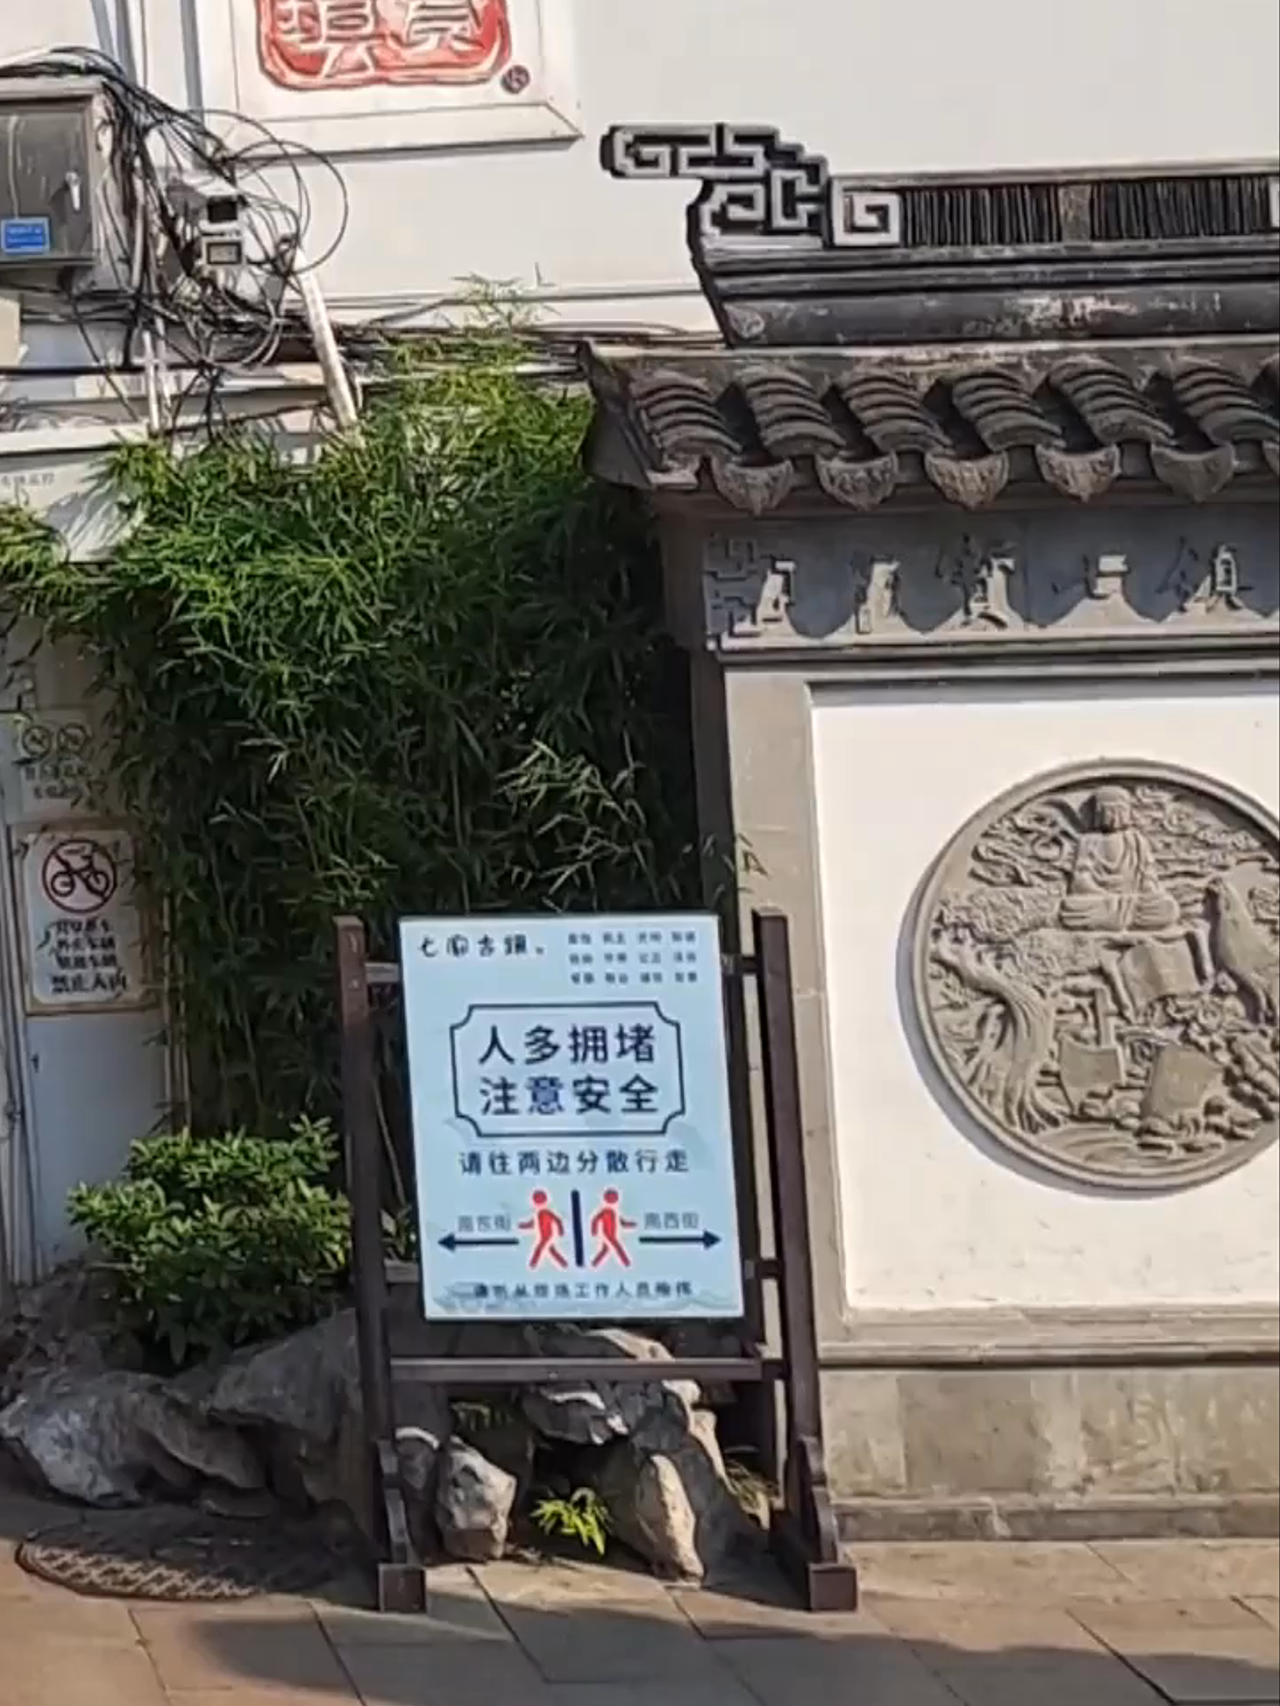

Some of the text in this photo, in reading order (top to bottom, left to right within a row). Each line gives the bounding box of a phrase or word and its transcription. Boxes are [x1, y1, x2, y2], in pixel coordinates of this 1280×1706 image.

[477, 1023, 656, 1064] 人多拥堵
[479, 1074, 659, 1115] 注意安全
[458, 1148, 690, 1176] 请往两边分散行走
